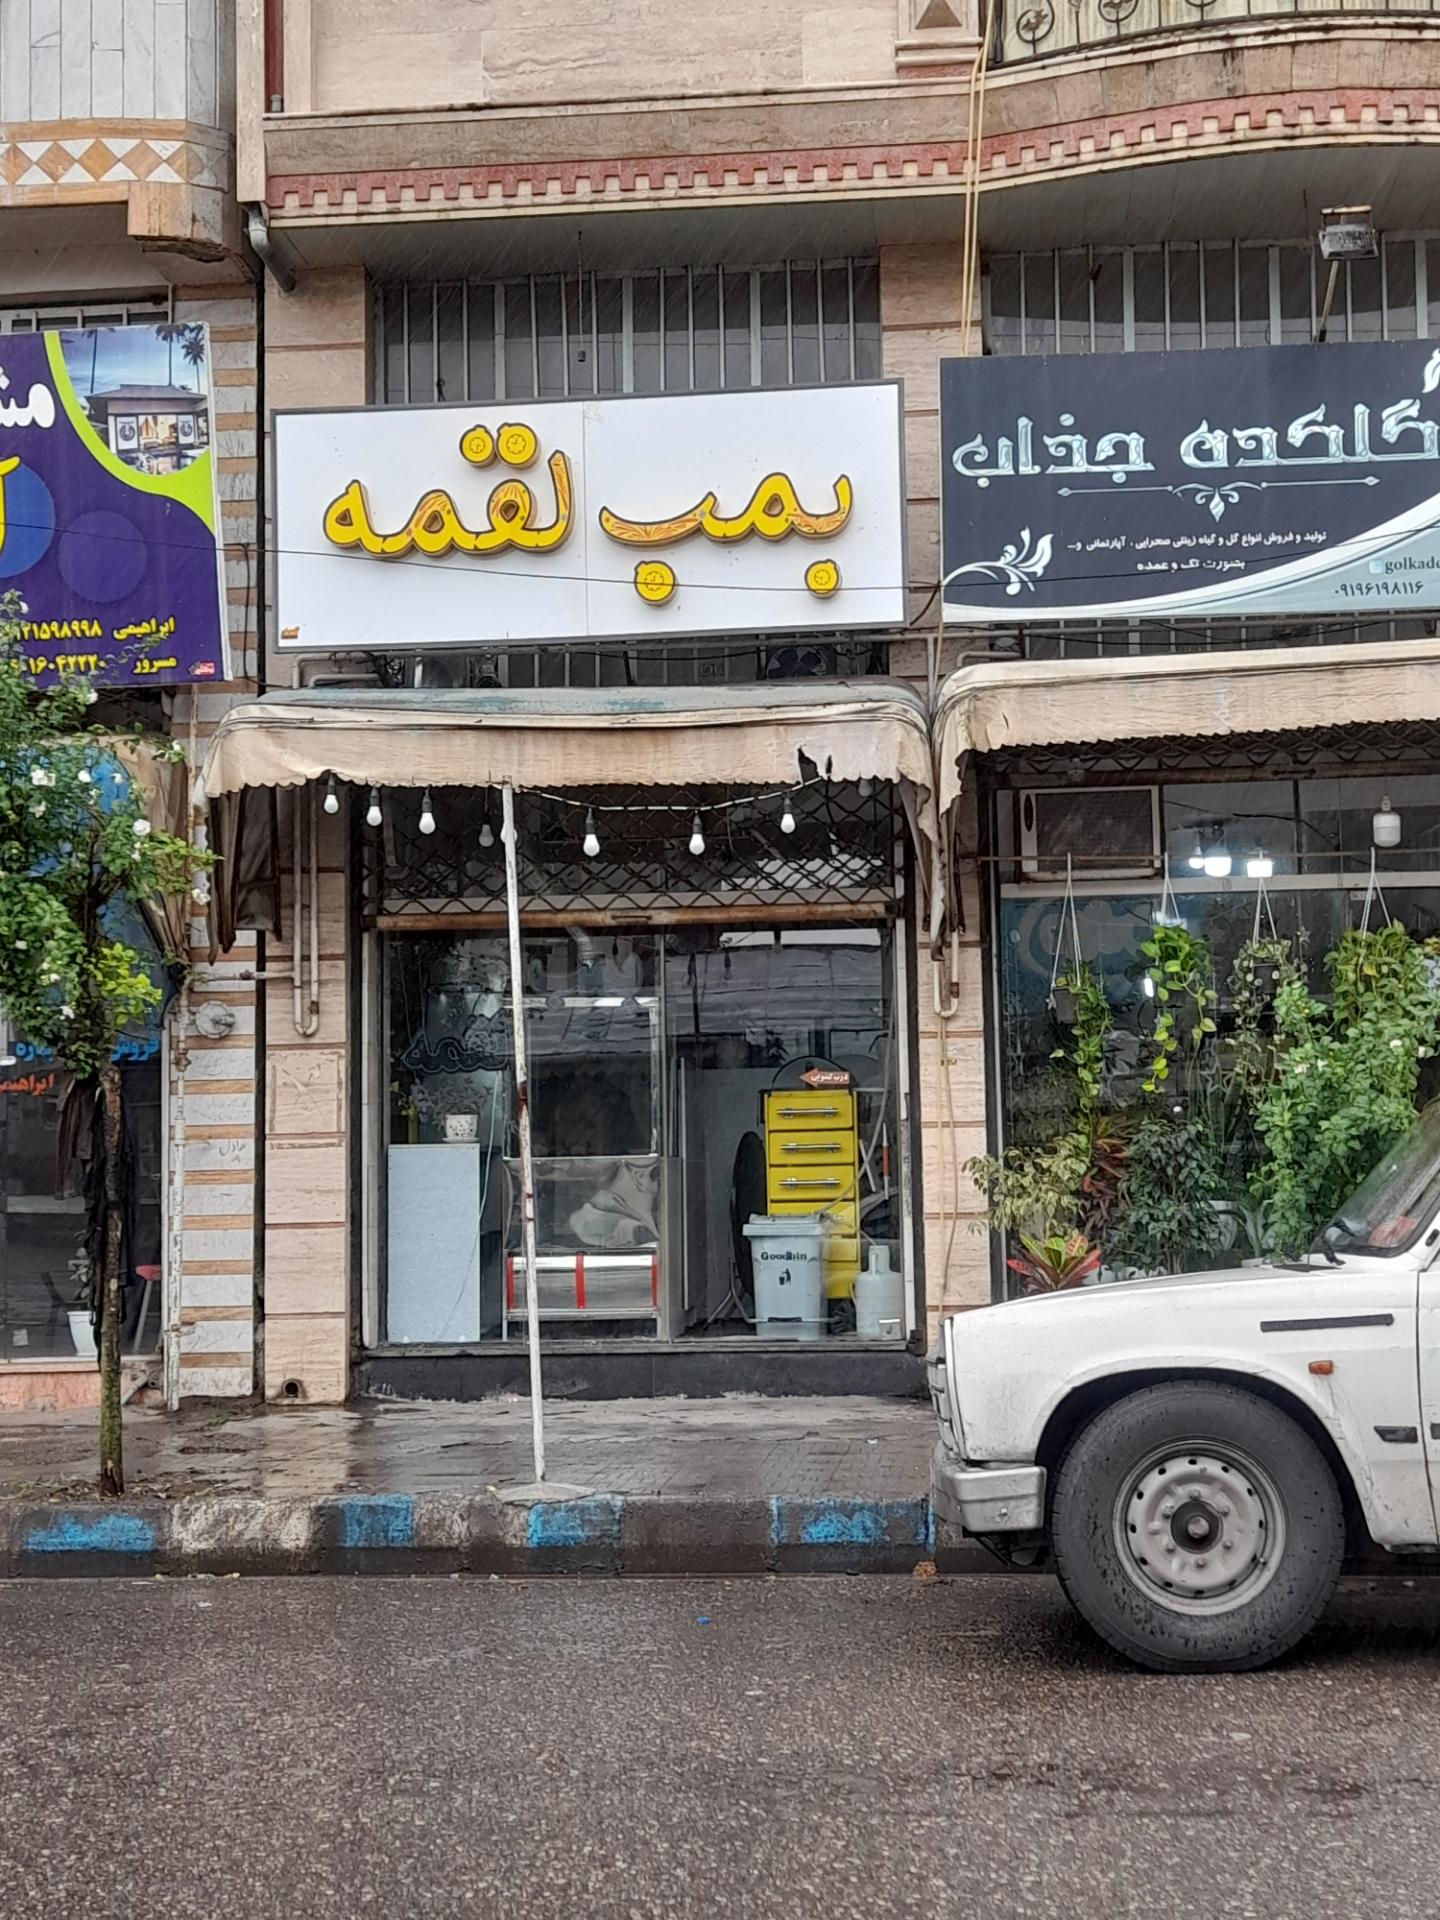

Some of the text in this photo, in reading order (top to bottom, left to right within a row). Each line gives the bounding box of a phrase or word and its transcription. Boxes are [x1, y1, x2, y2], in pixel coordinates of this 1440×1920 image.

[951, 412, 1156, 489] جذاب
[322, 422, 854, 606] بمب لقمه
[1086, 536, 1127, 551] آپارتمانی
[1172, 535, 1196, 548] زینتی
[1198, 533, 1216, 546] گیاه
[1217, 536, 1224, 546] و
[1225, 532, 1239, 546] گل
[1241, 532, 1262, 547] انواع
[1263, 531, 1294, 545] فروش
[1295, 533, 1301, 544] و
[1303, 531, 1327, 543] تولید
[1136, 561, 1169, 571] عمده
[1180, 558, 1200, 569] تک
[1334, 581, 1424, 597] ۰۹۱۹۶۱۹۸۱۱۶
[113, 615, 175, 641] ابراهیمی
[132, 657, 178, 675] مسرور
